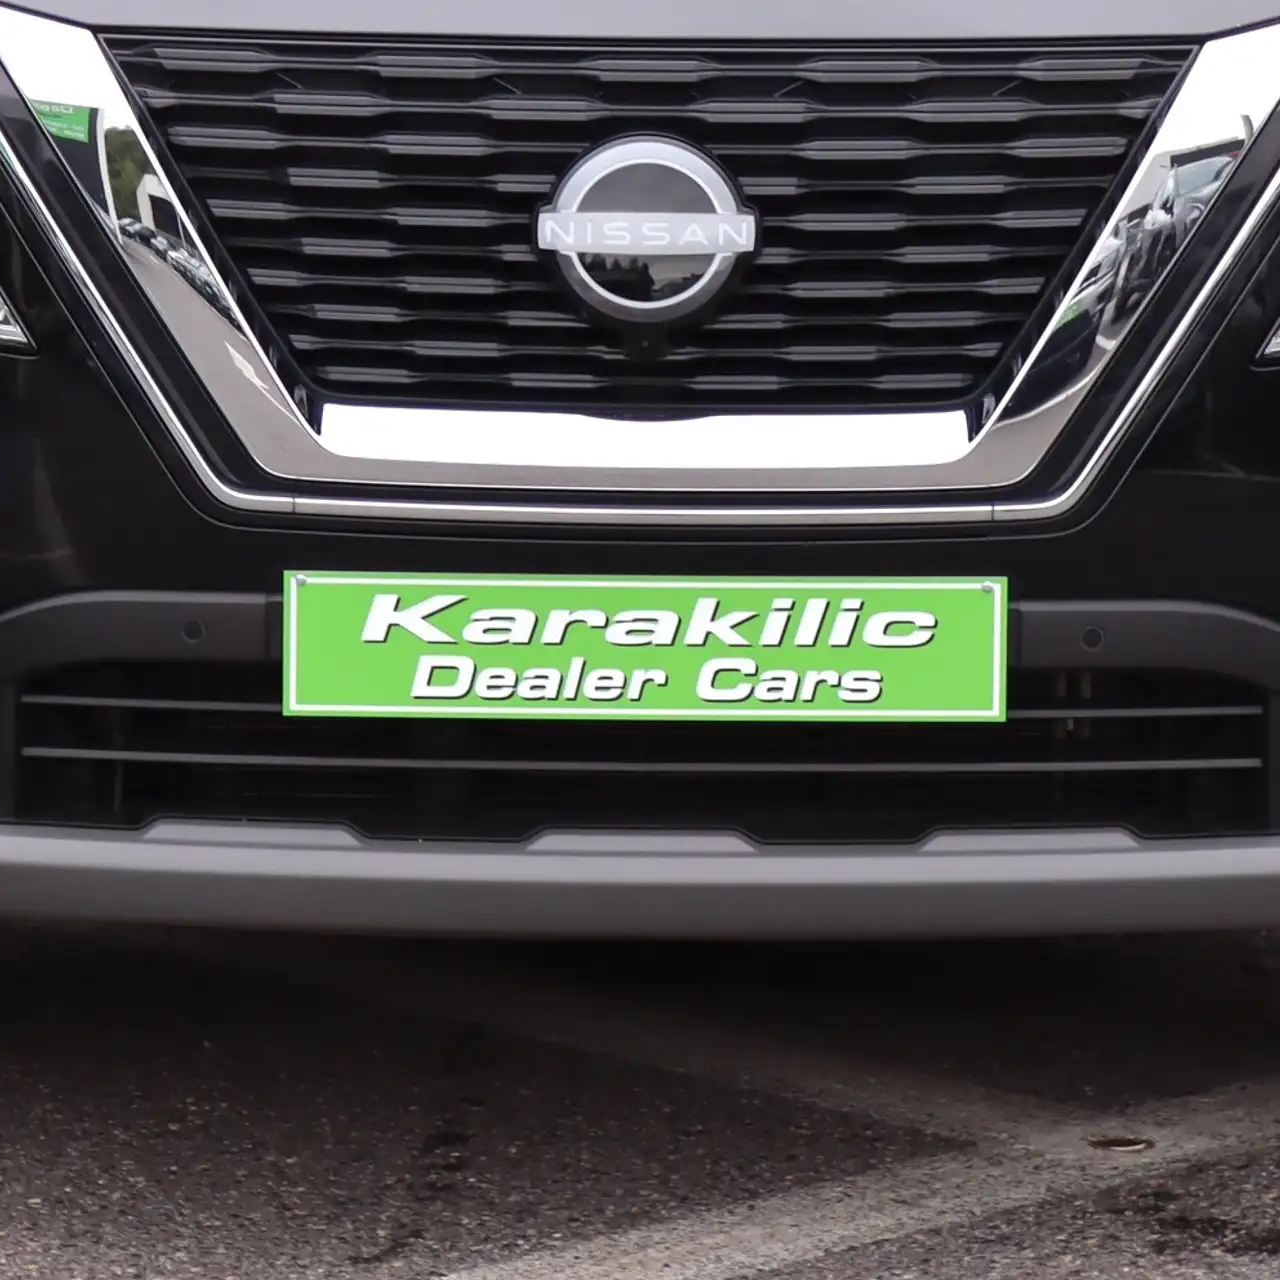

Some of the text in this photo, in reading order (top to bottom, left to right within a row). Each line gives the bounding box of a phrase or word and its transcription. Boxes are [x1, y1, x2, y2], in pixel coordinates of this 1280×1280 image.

[544, 221, 748, 246] NISSAN
[361, 593, 938, 649] Karakilic
[410, 655, 884, 705] Dealer Cars
